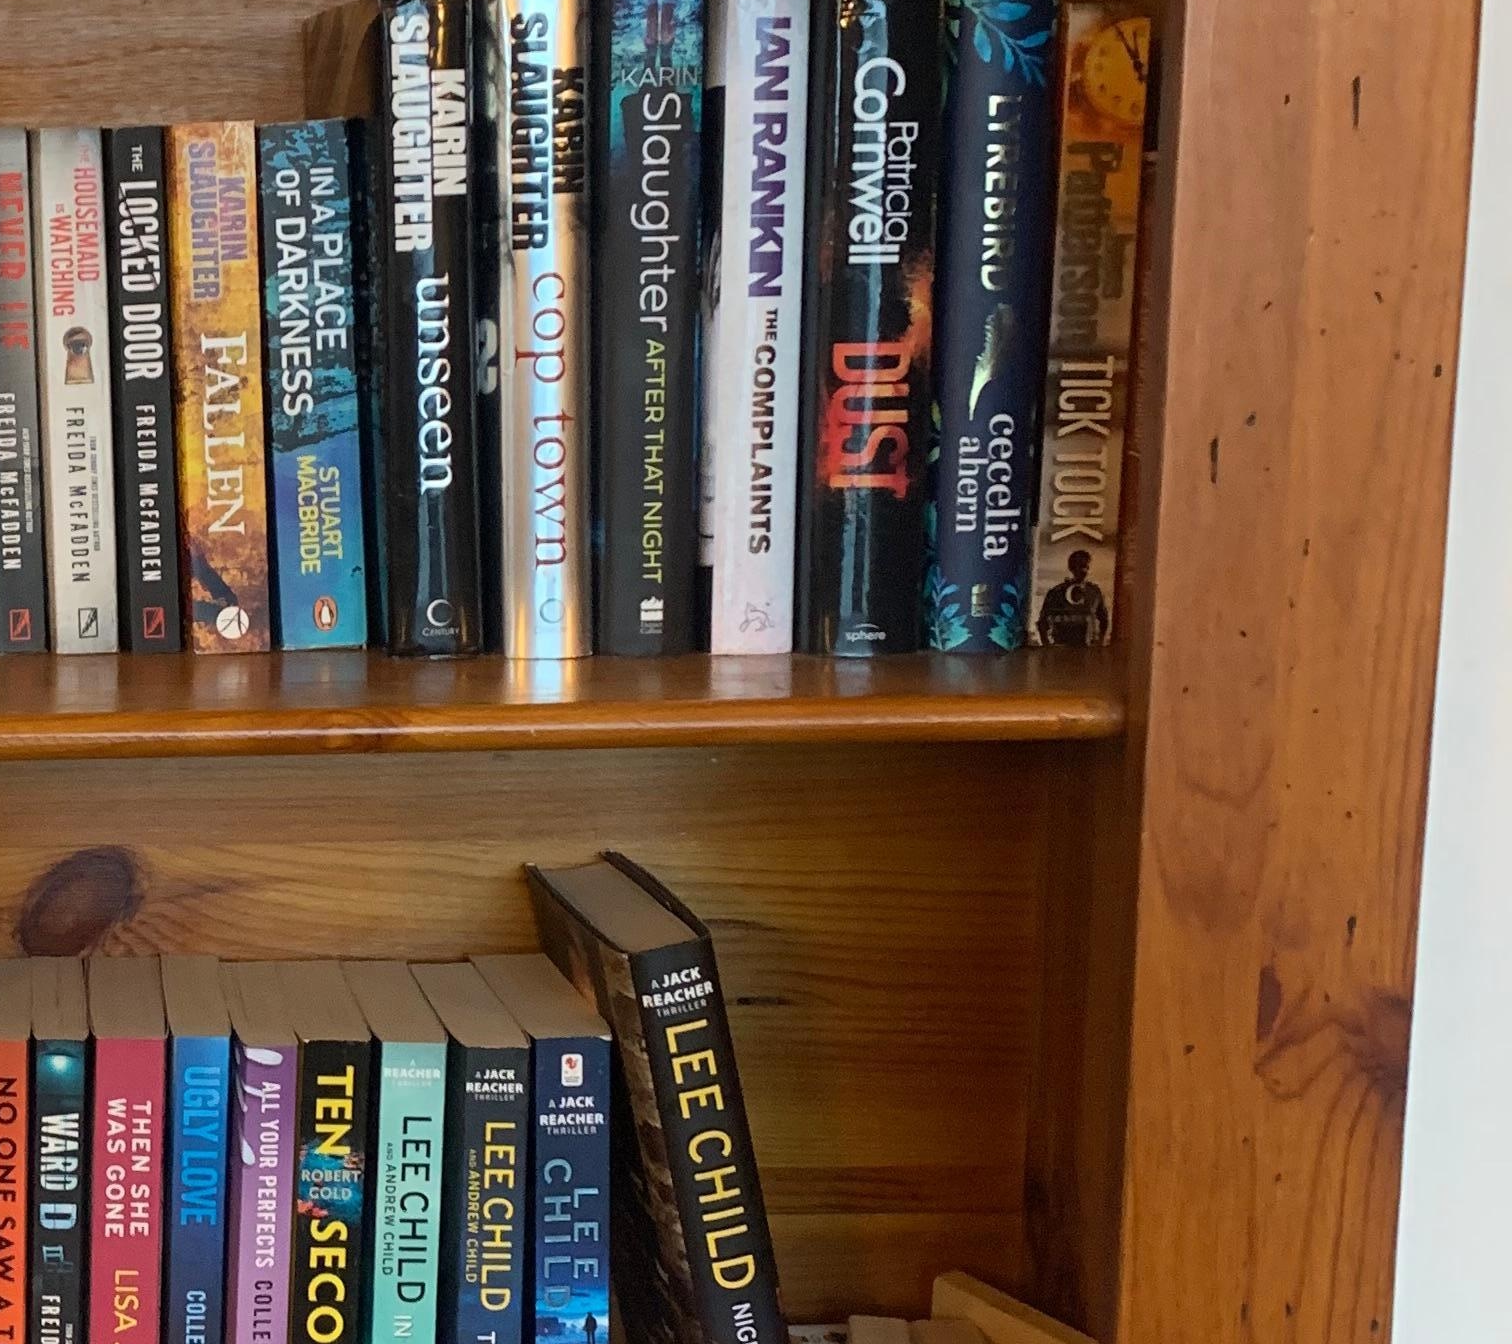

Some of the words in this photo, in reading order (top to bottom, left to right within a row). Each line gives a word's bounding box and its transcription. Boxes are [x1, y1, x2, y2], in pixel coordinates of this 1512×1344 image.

[754, 17, 789, 103] IAN
[130, 145, 144, 172] THE
[389, 15, 433, 252] SLAUGHTER
[431, 69, 466, 195] KARIN
[846, 58, 905, 264] Cornwell
[275, 169, 299, 205] OF
[311, 166, 334, 198] IN
[313, 205, 333, 225] A
[630, 92, 680, 333] Slaughter
[748, 111, 789, 297] RANKIN
[884, 121, 918, 242] Patricia
[118, 179, 162, 291] LOCKED
[276, 217, 313, 415] DARKNESS
[313, 232, 346, 350] PLACE
[762, 309, 777, 342] THE
[122, 303, 164, 381] DOOR
[415, 271, 454, 495] unseen
[643, 339, 665, 422] AFTER
[136, 405, 158, 472] FREIDA
[200, 331, 247, 534] FALLEN
[644, 429, 664, 491] THAT
[749, 343, 776, 554] COMPLAINTS
[828, 340, 910, 498] DUST
[297, 456, 320, 575] MACBRIDE
[318, 467, 342, 559] STUART
[955, 436, 985, 533] ahern
[983, 413, 1019, 560] cecelia
[138, 484, 161, 582] McFADDEN
[640, 502, 664, 583] NIGHT
[259, 1082, 281, 1115] ALL
[314, 1065, 354, 1157] TEN
[665, 1017, 724, 1119] LEE
[107, 1098, 126, 1155] WAS
[131, 1100, 152, 1172] THEN
[258, 1120, 278, 1167] YOUR
[105, 1165, 126, 1237] GONE
[130, 1184, 150, 1236] SHE
[254, 1175, 276, 1268] PERFECTS
[688, 1130, 756, 1290] CHILD
[113, 1269, 139, 1334] LISA
